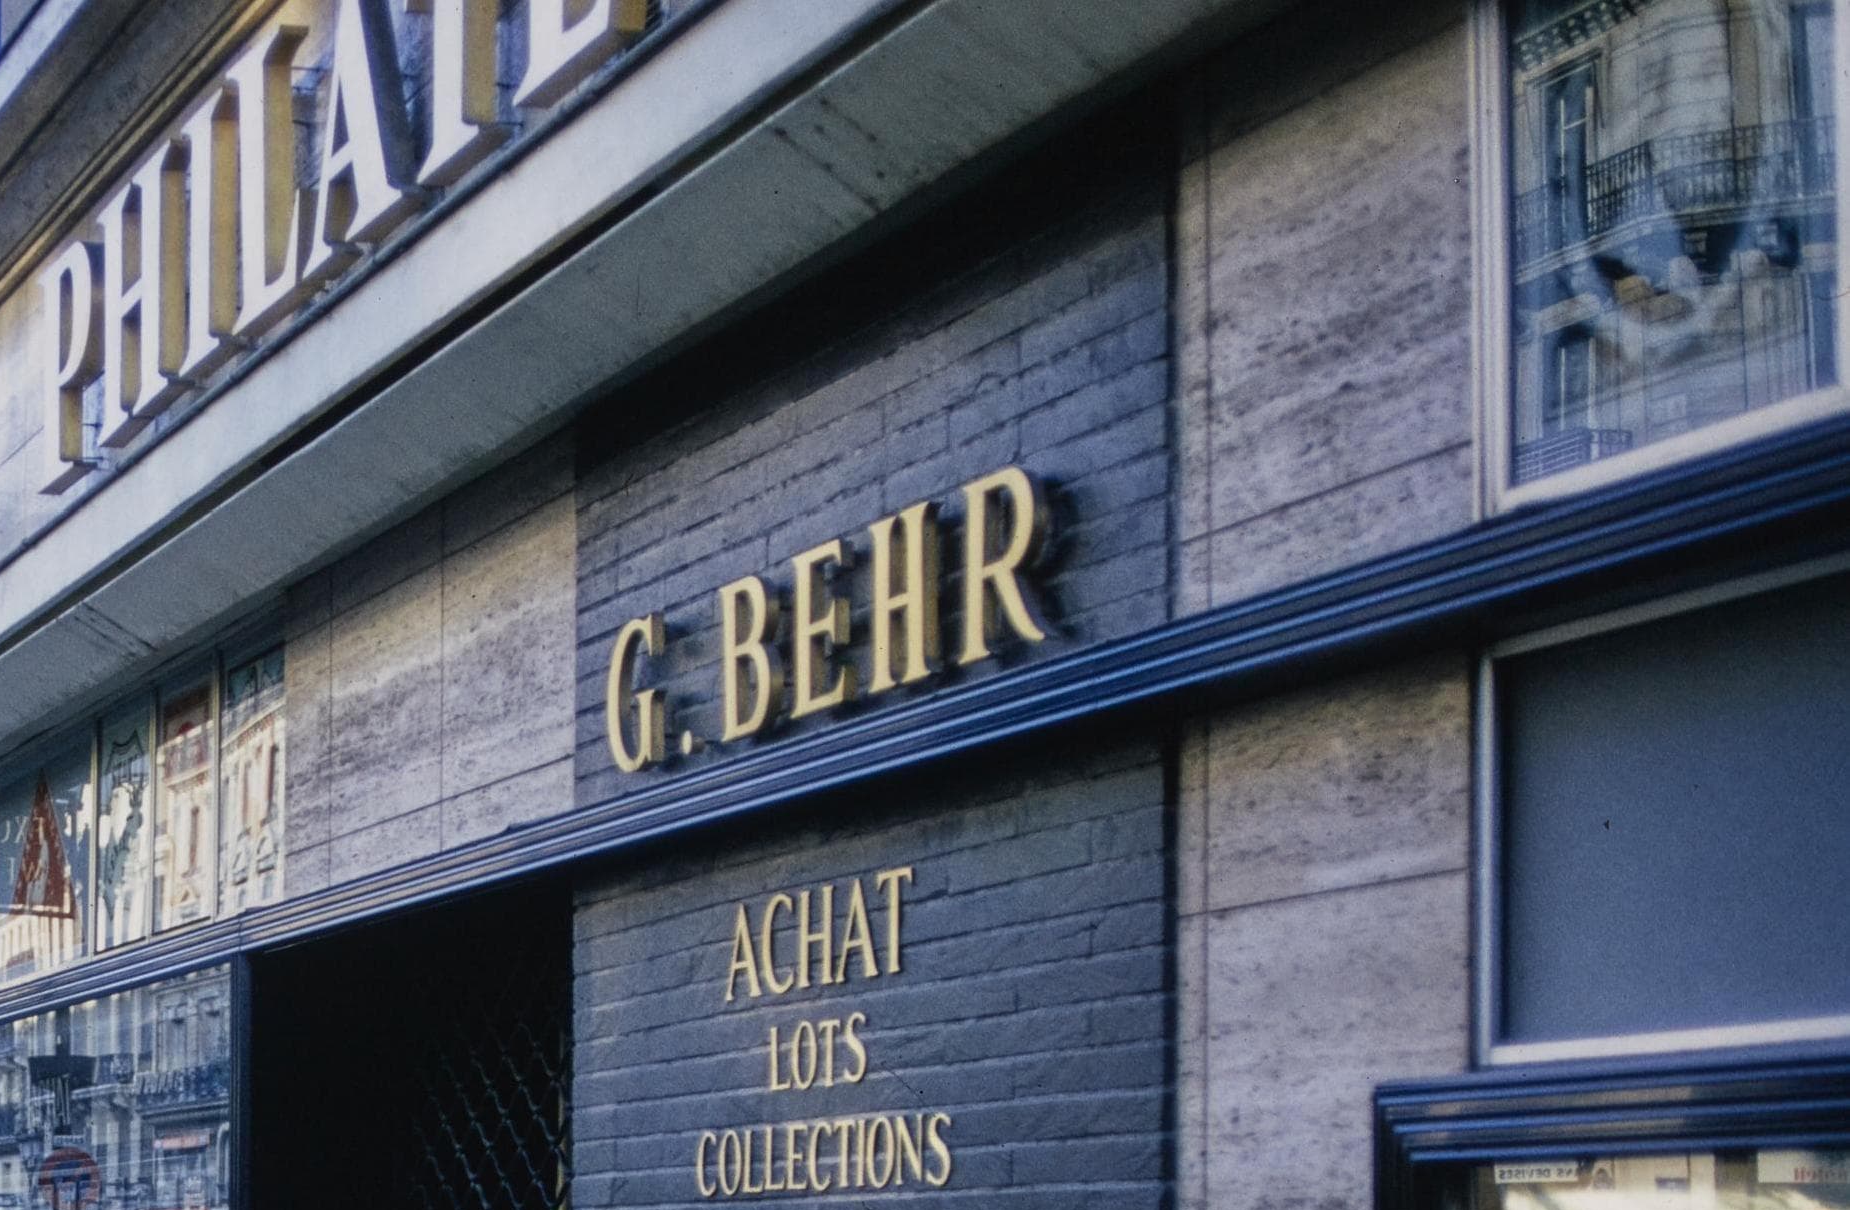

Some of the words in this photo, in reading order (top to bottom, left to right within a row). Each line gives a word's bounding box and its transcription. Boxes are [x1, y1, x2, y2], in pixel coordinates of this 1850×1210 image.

[606, 614, 693, 773] G.
[718, 464, 1046, 742] BEHR
[724, 866, 914, 1002] ACHAT
[766, 1011, 868, 1092] LOTS
[695, 1111, 952, 1197] COLLECTIONS
